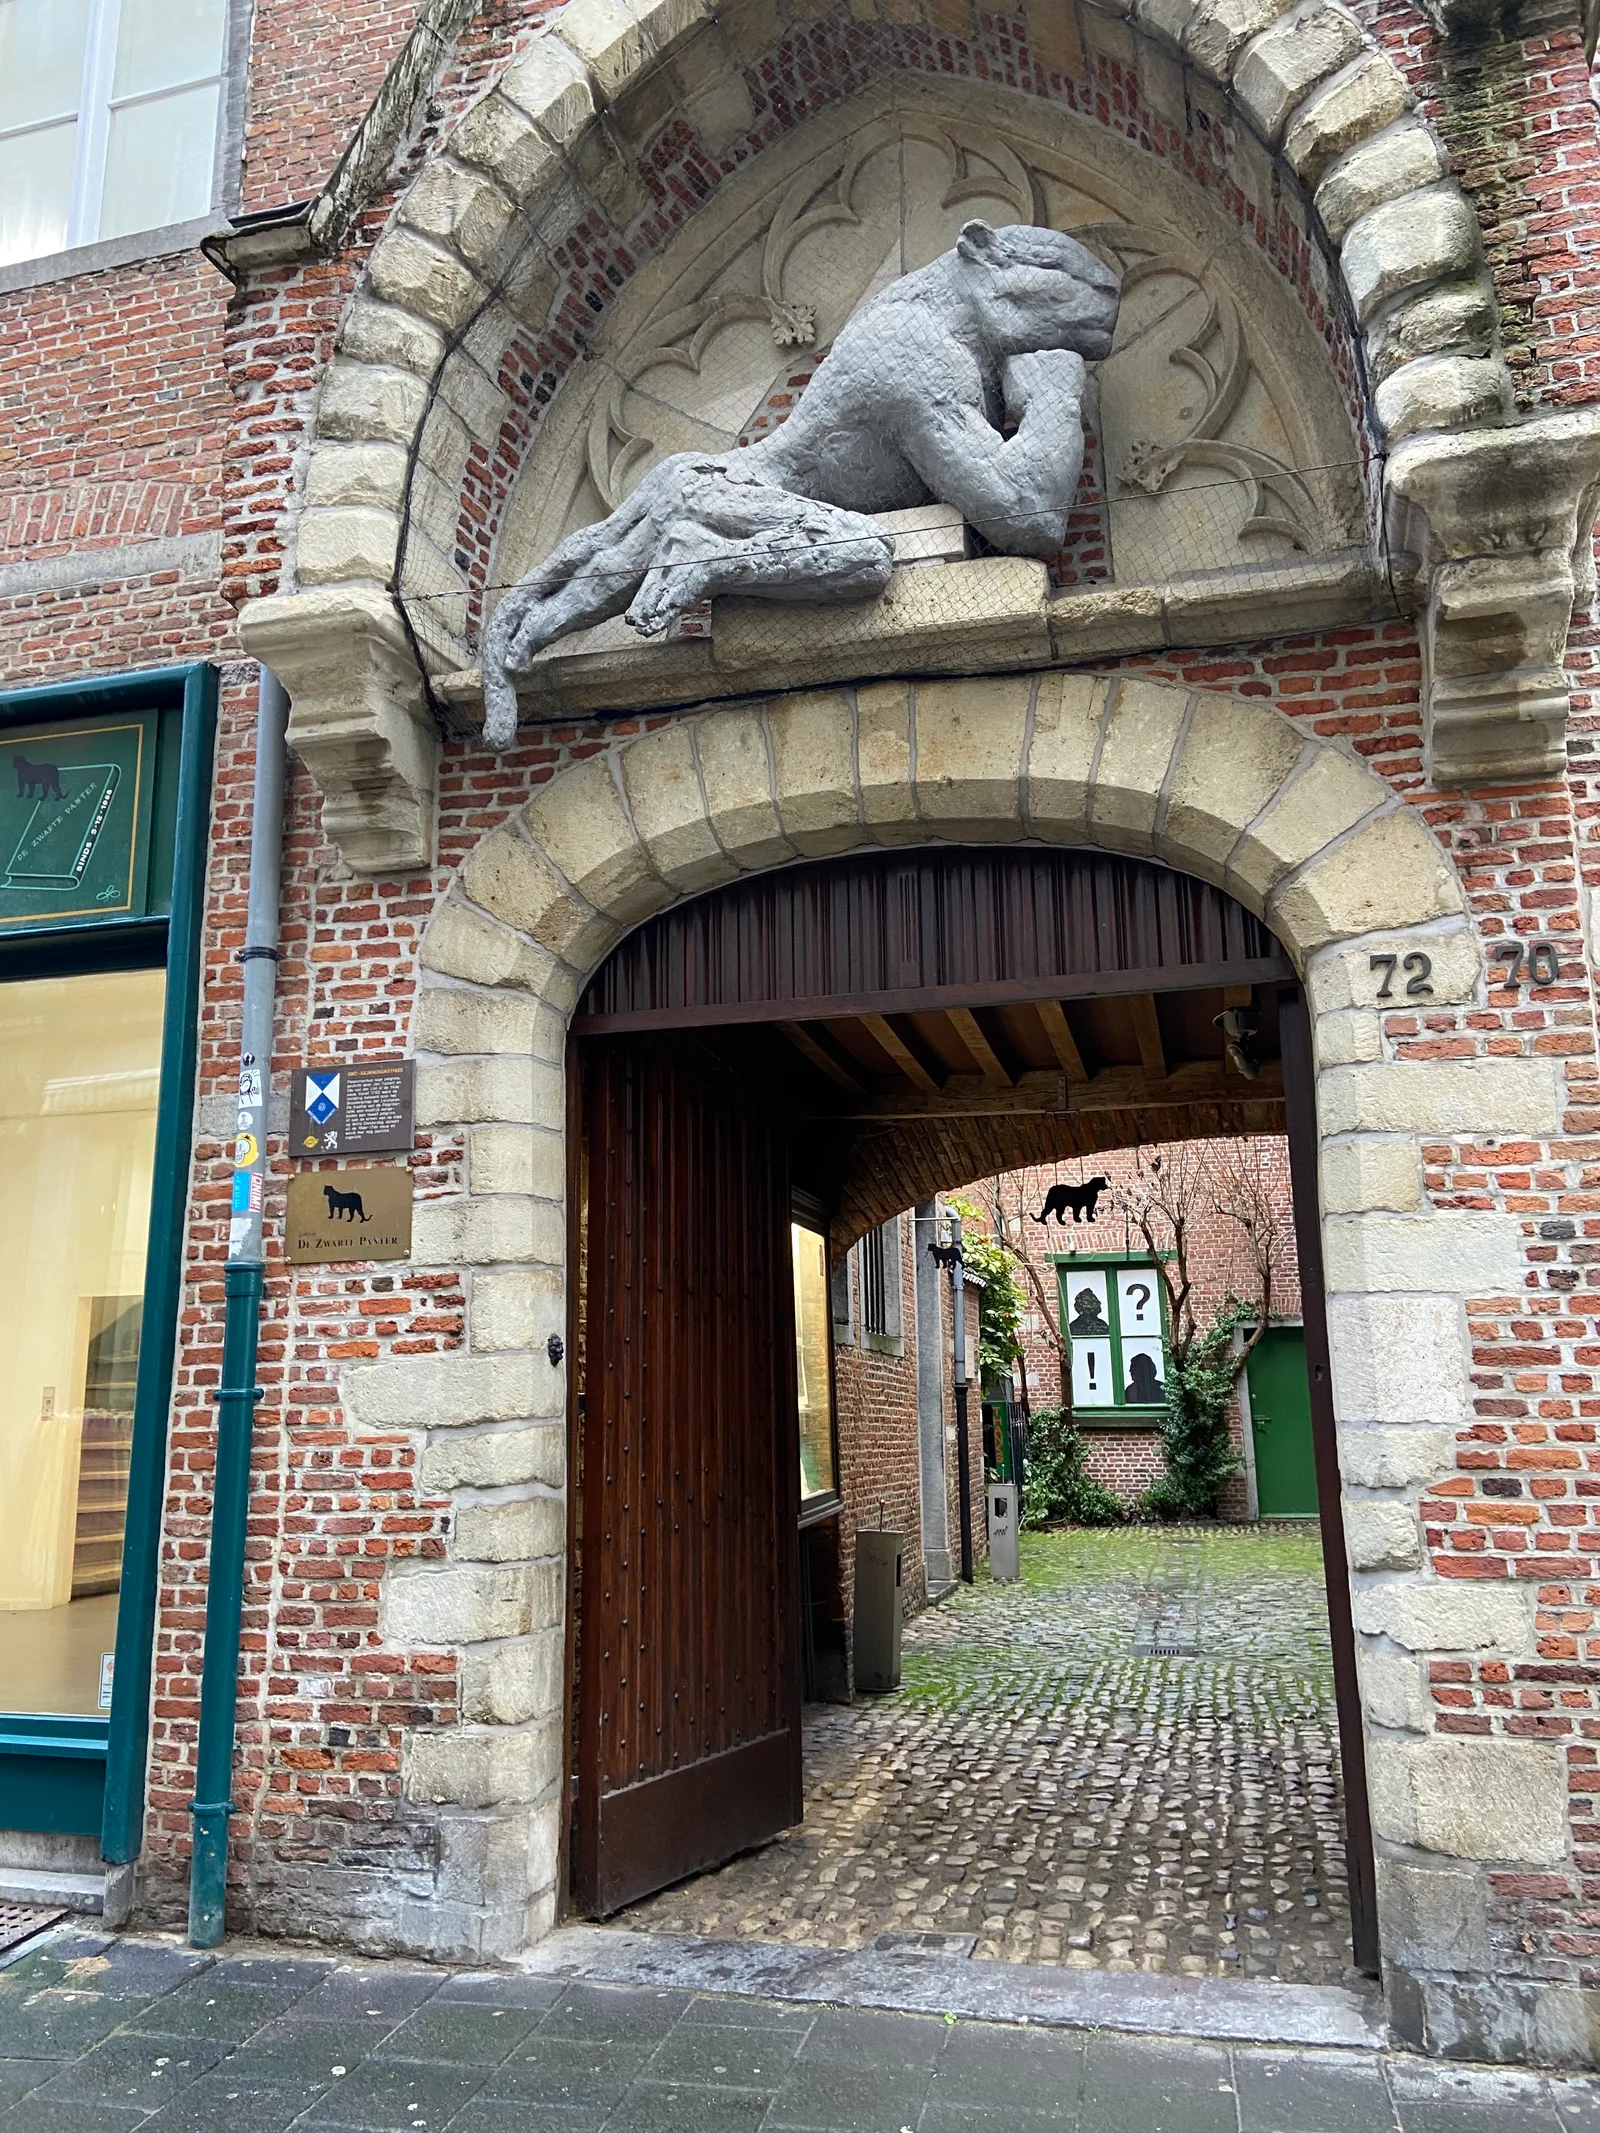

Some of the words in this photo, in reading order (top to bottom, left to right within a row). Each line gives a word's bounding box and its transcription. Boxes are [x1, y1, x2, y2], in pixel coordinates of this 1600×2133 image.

[64, 782, 98, 815] PANTER
[76, 841, 93, 873] SINDS
[1369, 951, 1434, 998] 72
[1495, 940, 1559, 989] 70
